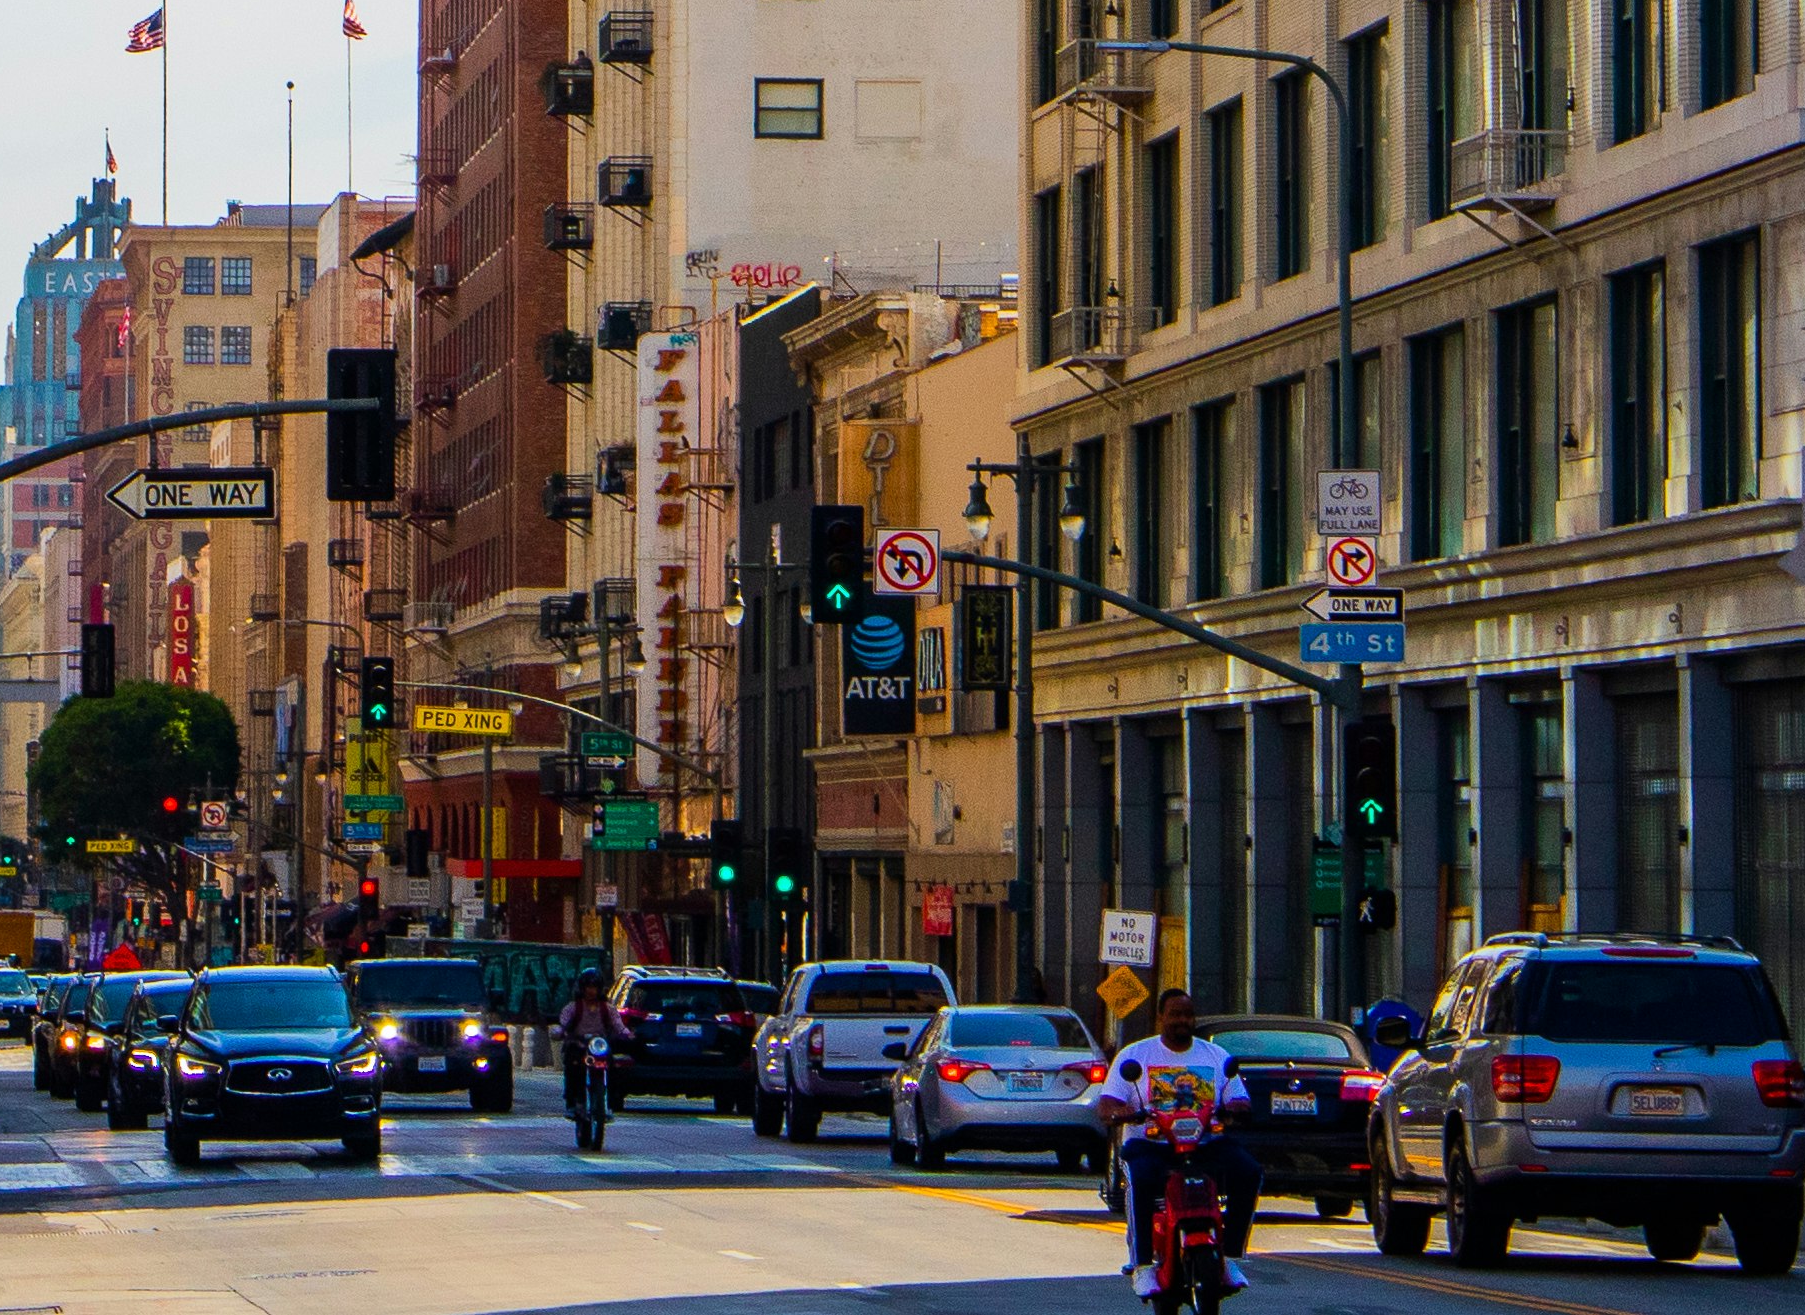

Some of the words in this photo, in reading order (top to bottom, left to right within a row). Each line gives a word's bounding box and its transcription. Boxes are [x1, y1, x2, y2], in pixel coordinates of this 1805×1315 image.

[144, 483, 193, 507] ONE
[209, 482, 259, 506] WAY
[1325, 505, 1349, 517] MAY
[1351, 505, 1373, 517] USE
[1320, 519, 1348, 531] FULL
[1350, 519, 1379, 530] LANE
[1331, 599, 1359, 612] ONE
[1364, 598, 1393, 612] WAY
[173, 594, 190, 655] LOS
[1309, 631, 1356, 656] 4th
[1367, 633, 1396, 654] St
[845, 676, 911, 701] AT&T
[422, 711, 457, 728] PED
[463, 713, 503, 732] XING
[1121, 918, 1135, 929] NO
[1109, 932, 1144, 944] MOTOR
[1107, 945, 1145, 959] VEHICLES
